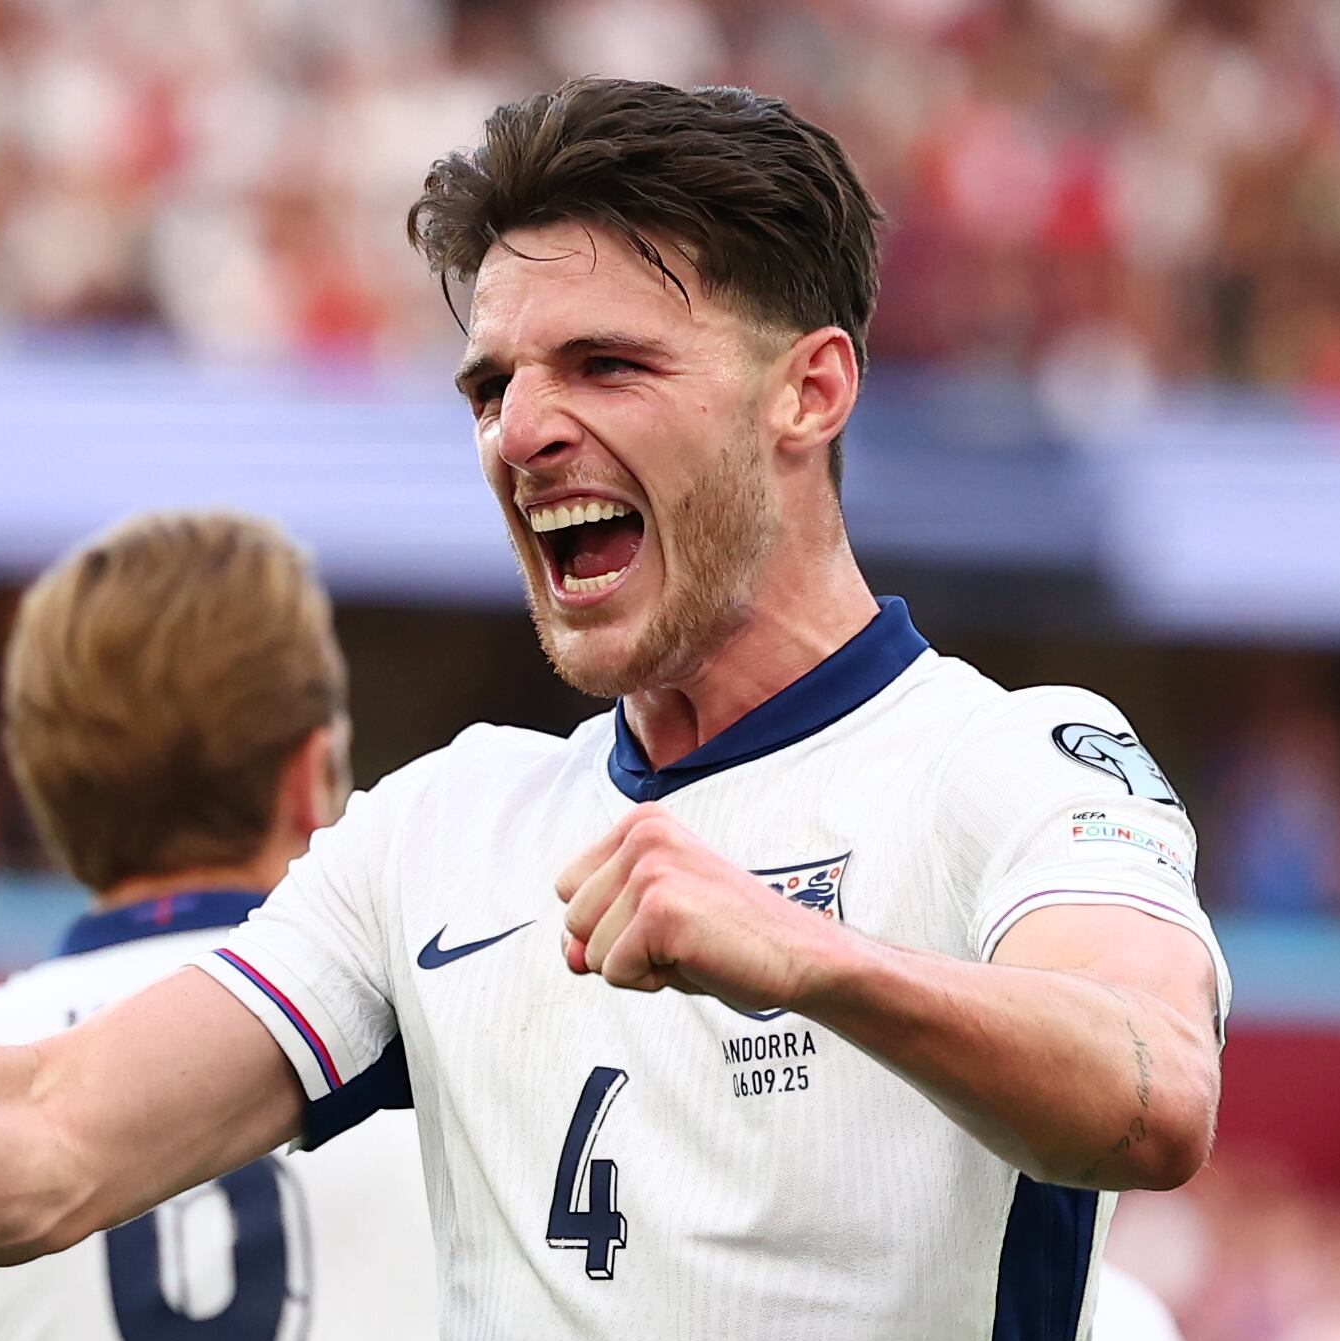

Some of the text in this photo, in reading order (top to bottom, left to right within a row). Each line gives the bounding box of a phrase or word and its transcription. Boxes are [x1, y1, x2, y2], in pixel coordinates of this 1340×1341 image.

[1072, 811, 1107, 820] UEFA
[721, 1030, 816, 1065] ANDORRA
[732, 1065, 809, 1098] 06.09.25
[545, 1065, 630, 1281] 4
